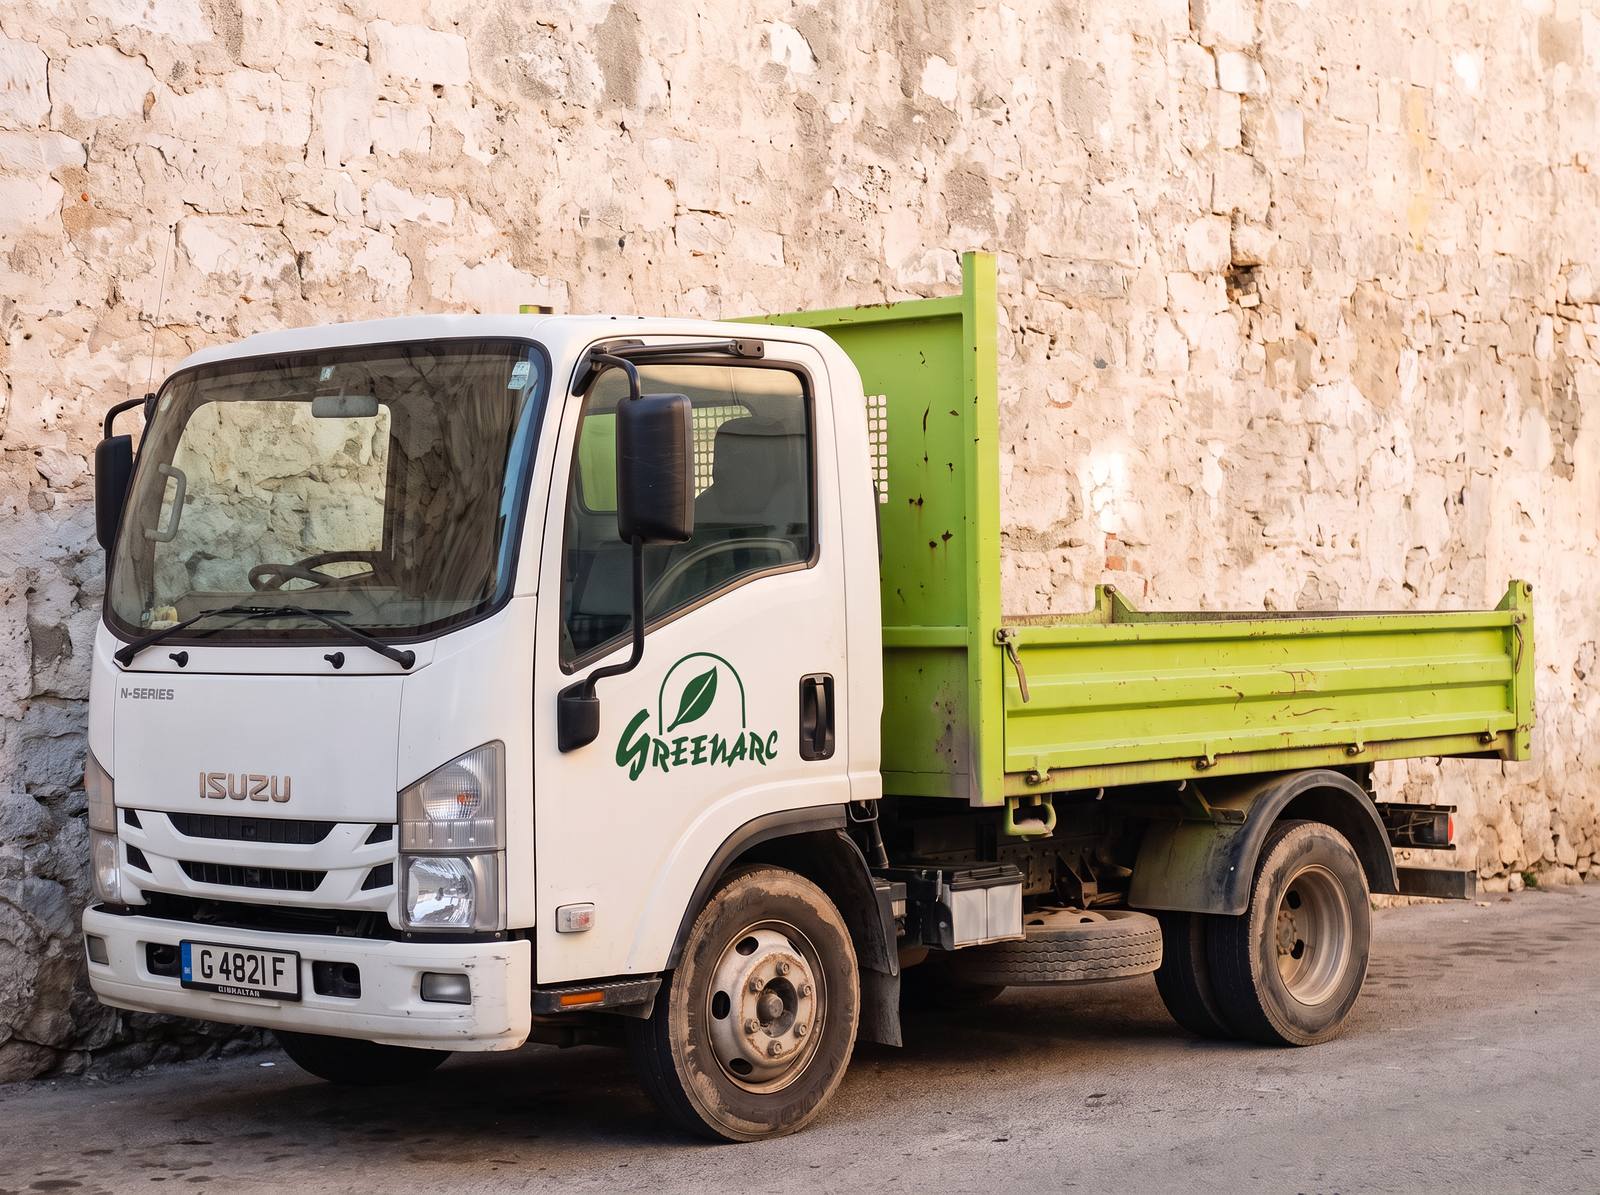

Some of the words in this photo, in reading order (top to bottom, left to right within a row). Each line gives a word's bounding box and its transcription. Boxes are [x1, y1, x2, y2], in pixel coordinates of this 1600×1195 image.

[120, 687, 175, 700] N-SERIES
[199, 771, 291, 803] ISUZU
[200, 949, 213, 979] G
[219, 951, 266, 986] 4821
[271, 956, 286, 987] F
